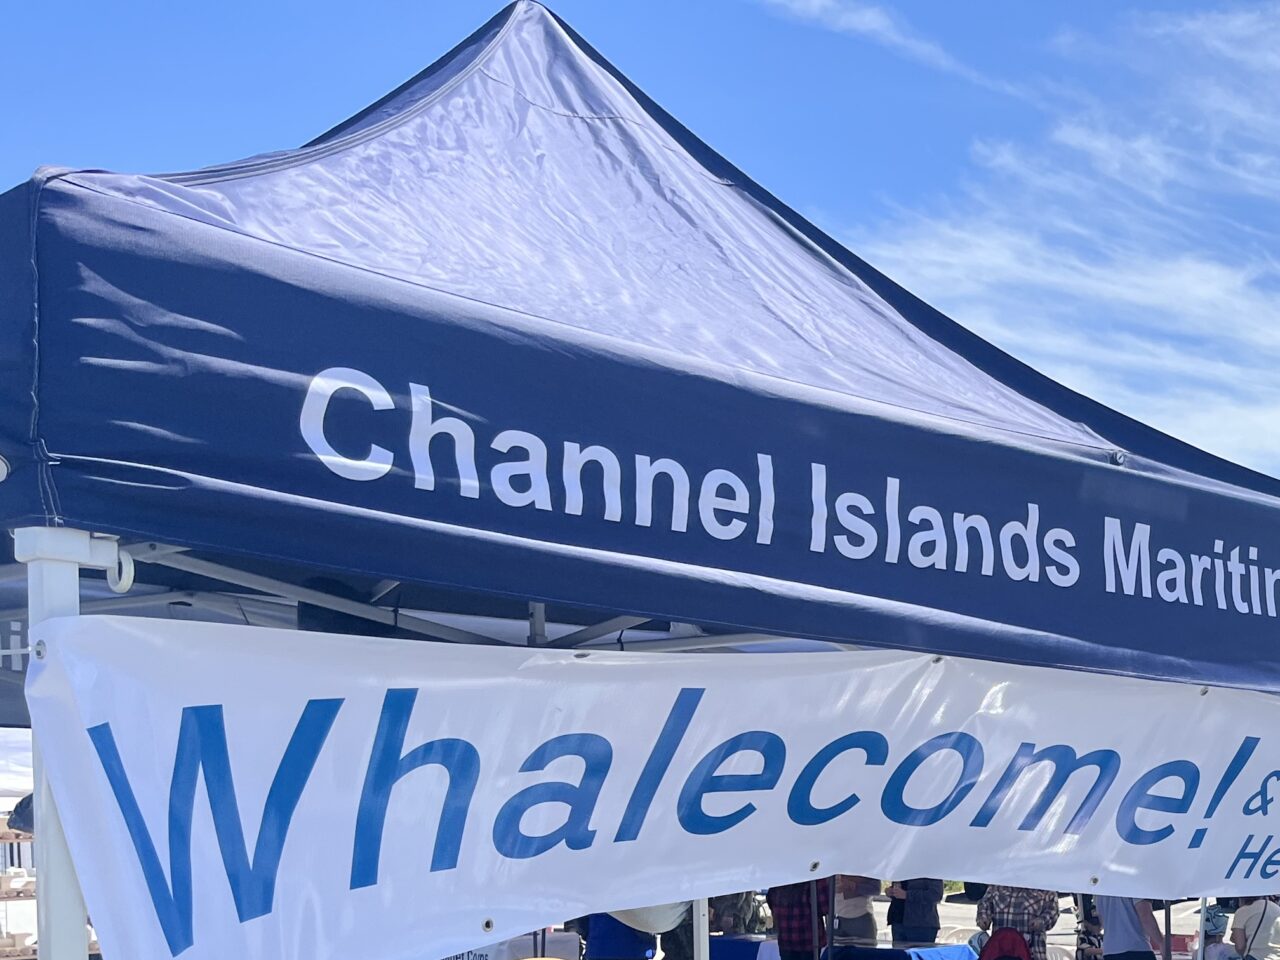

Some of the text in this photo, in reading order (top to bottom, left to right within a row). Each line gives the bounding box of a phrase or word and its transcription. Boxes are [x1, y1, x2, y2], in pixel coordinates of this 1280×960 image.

[300, 366, 775, 545] Channel
[809, 462, 1081, 589] Islands
[86, 686, 1261, 959] Whalecome!
